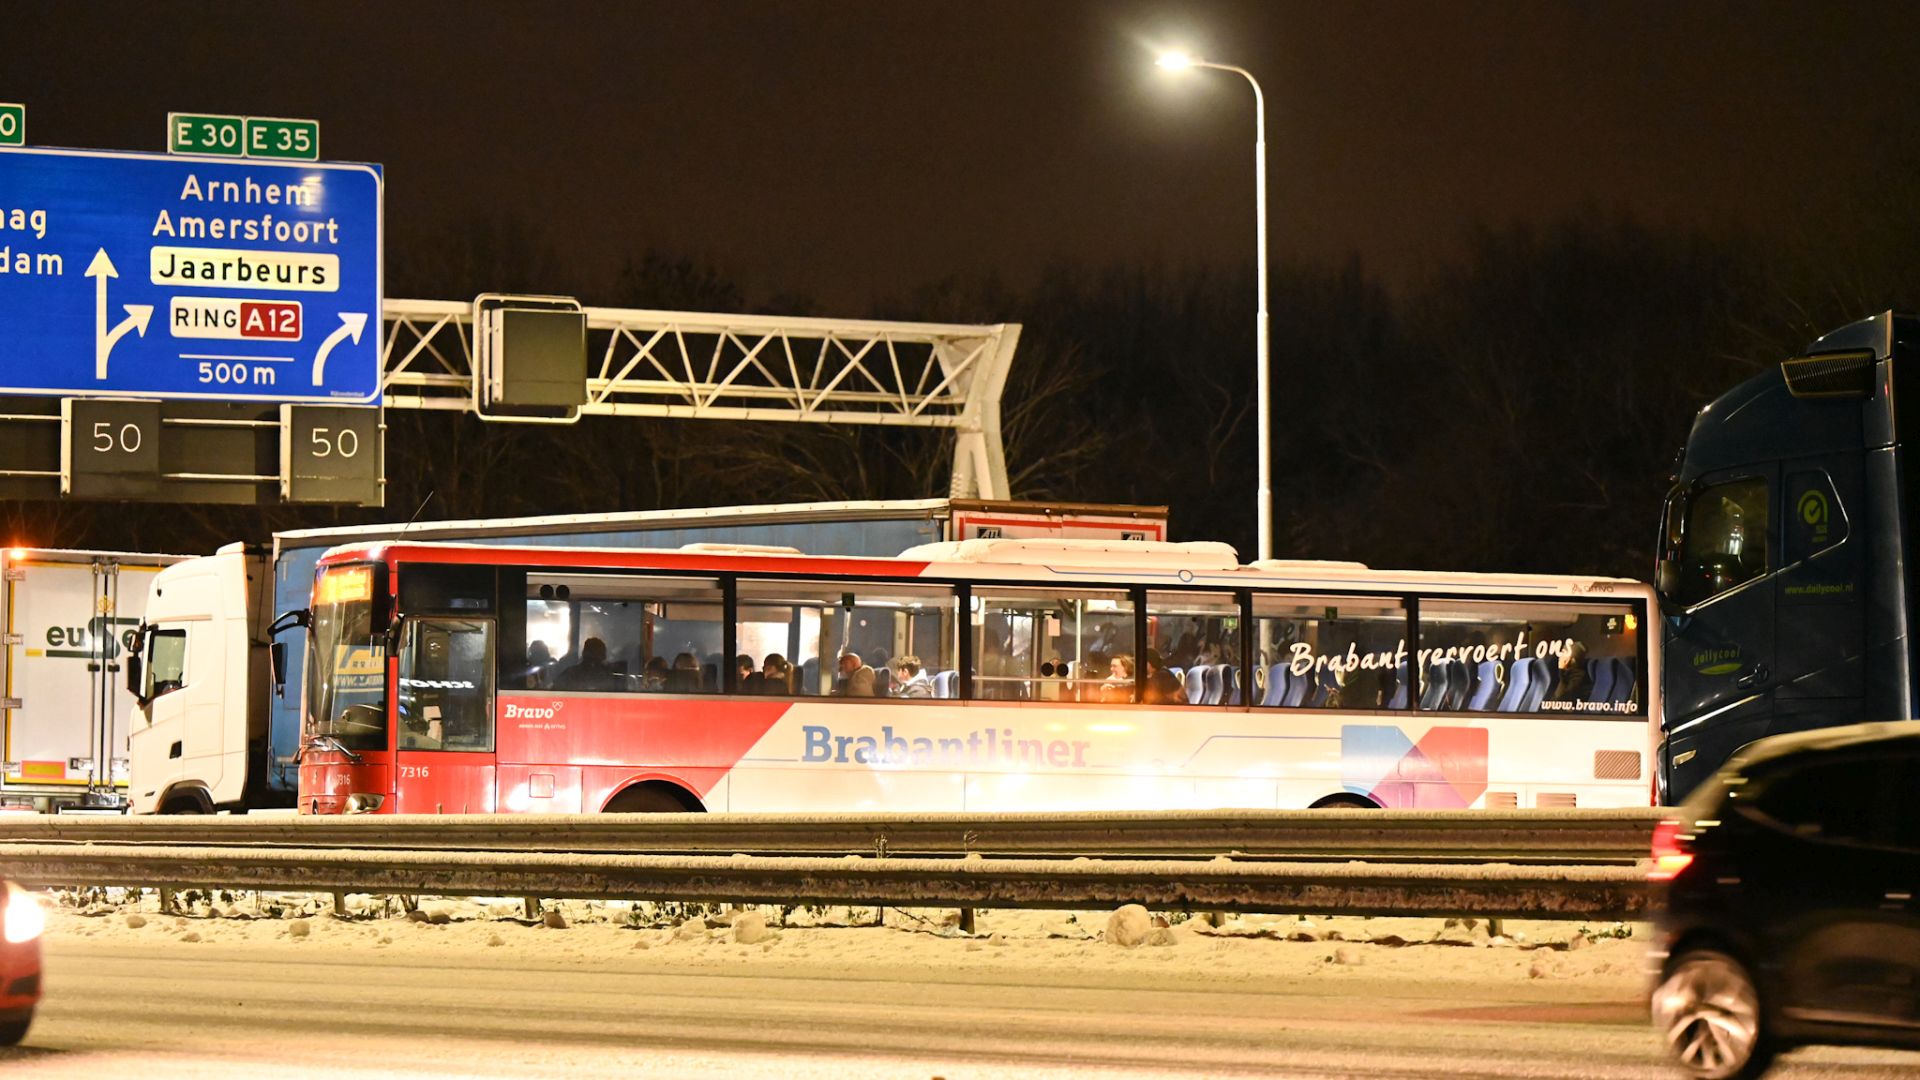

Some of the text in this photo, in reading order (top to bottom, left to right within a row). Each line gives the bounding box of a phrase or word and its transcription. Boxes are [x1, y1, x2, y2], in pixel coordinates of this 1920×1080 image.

[176, 122, 237, 149] E 30
[252, 126, 311, 152] E 35
[180, 174, 313, 206] Arnhem
[152, 210, 339, 244] Amersfoort
[158, 254, 327, 285] Jaarbeurs
[175, 307, 297, 333] RING A12
[198, 363, 276, 385] 500 m
[93, 423, 142, 453] 50
[311, 428, 358, 458] 50
[1289, 631, 1575, 677] Brabant vervoert ons
[504, 703, 554, 719] Bravo
[1541, 697, 1638, 713] www.bravo.info
[801, 725, 1091, 768] Brabantliner
[401, 766, 430, 778] 7316
